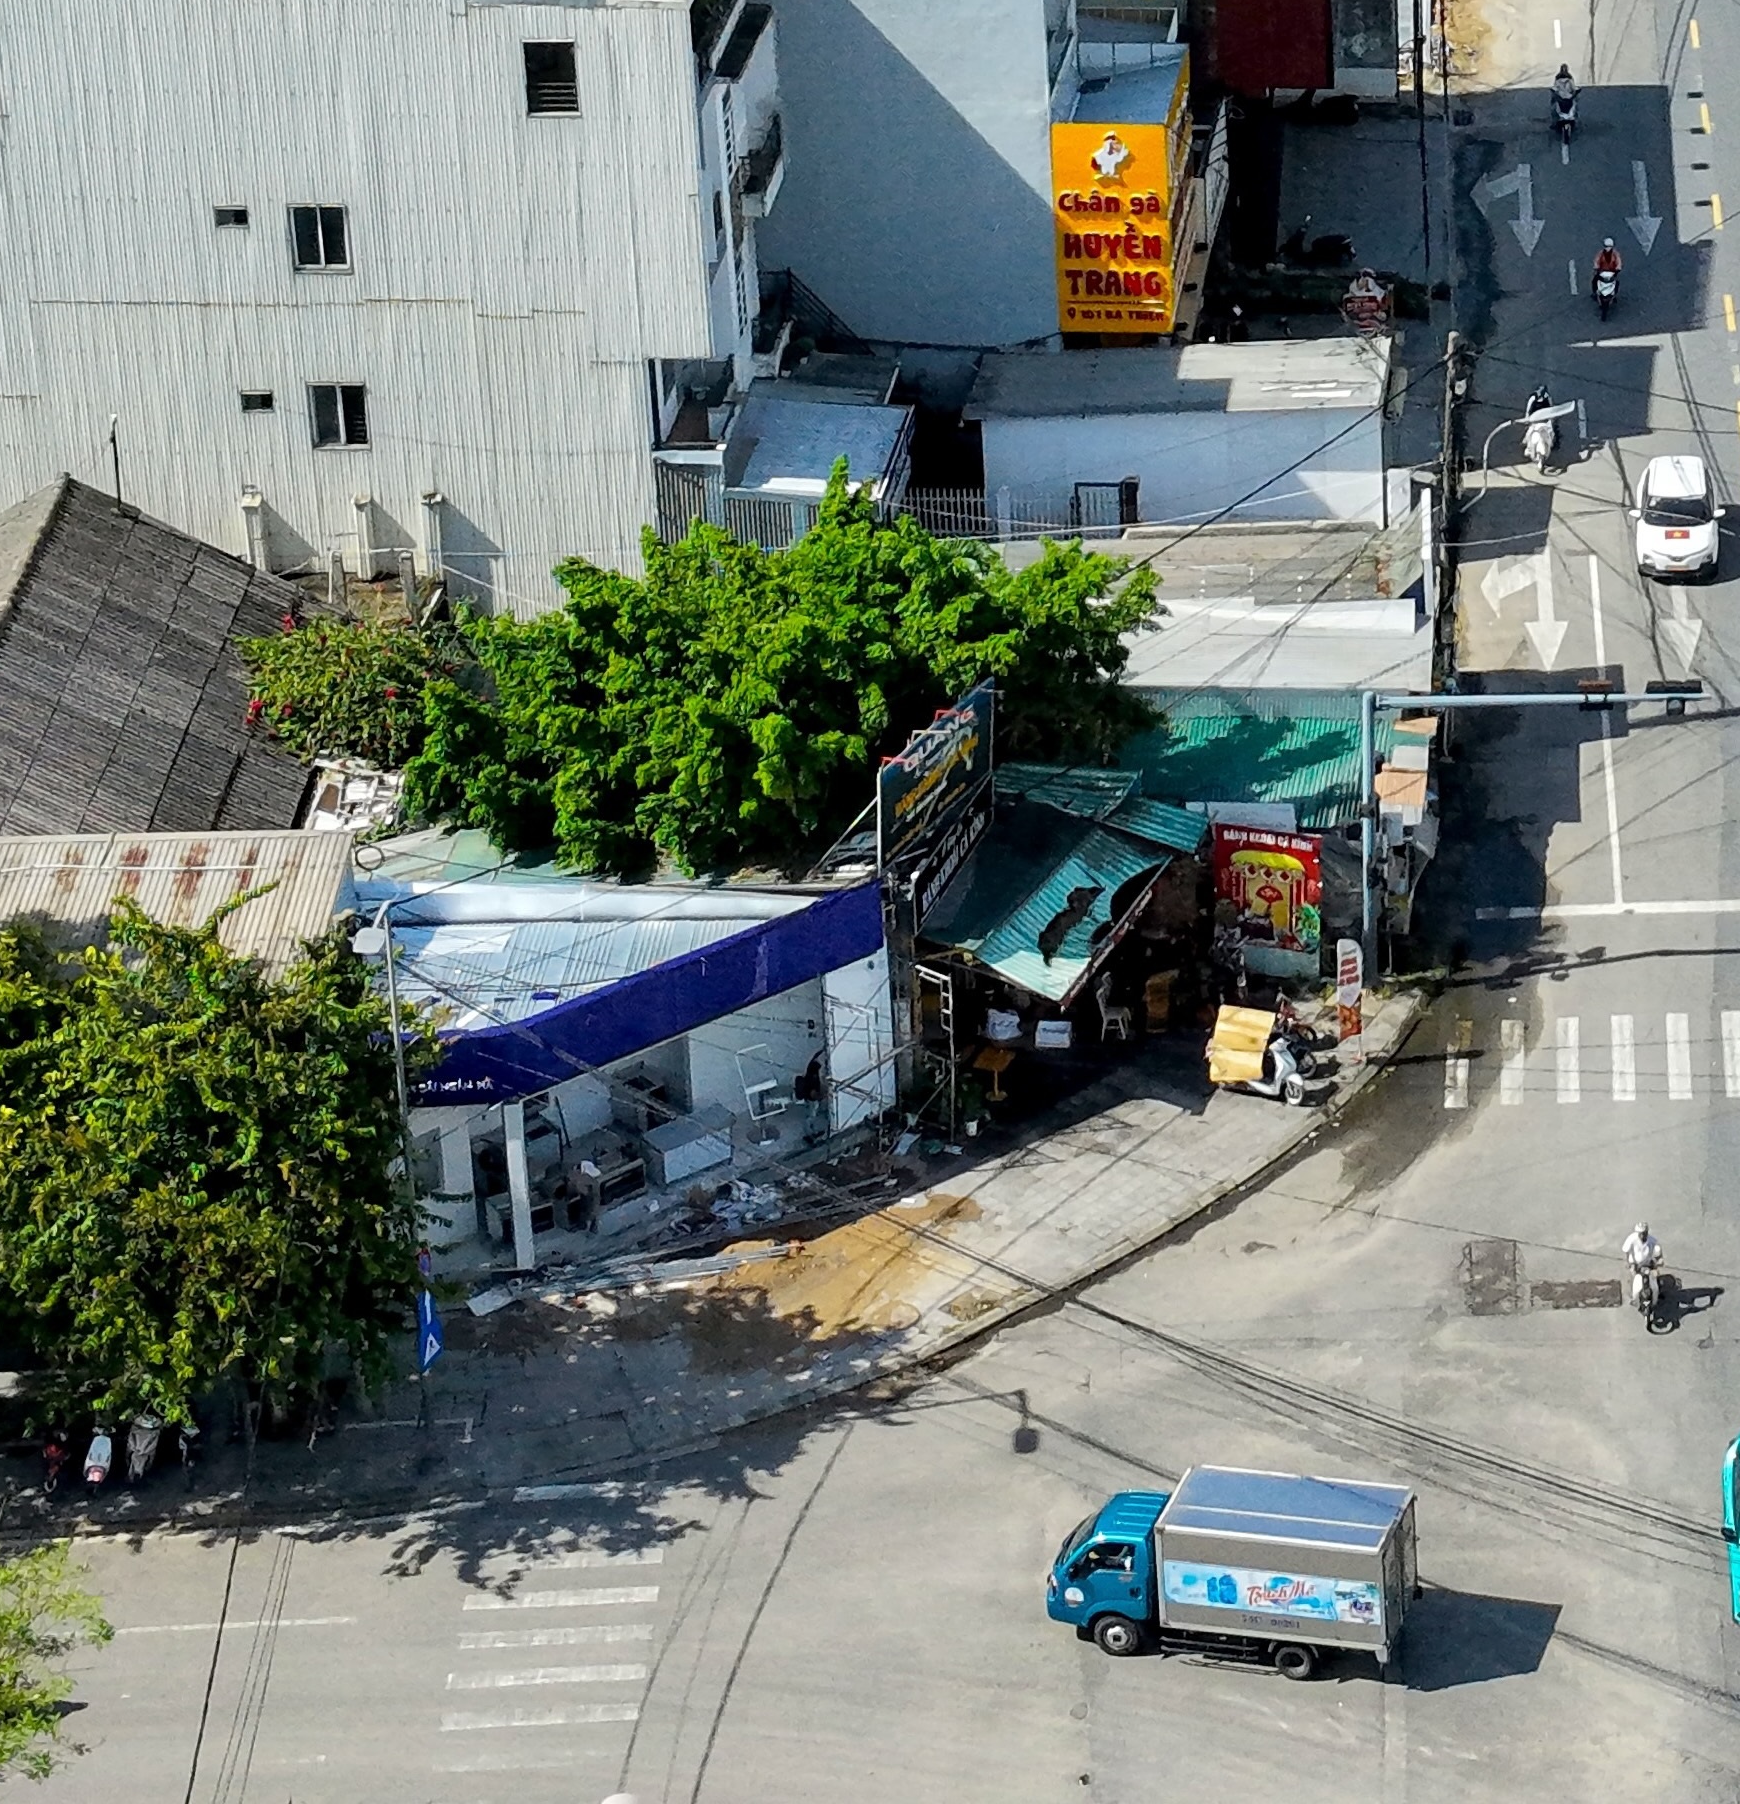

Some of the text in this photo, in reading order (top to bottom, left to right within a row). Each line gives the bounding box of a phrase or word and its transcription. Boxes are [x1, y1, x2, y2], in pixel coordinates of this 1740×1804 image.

[1058, 190, 1161, 216] Chân gà
[1065, 269, 1162, 298] TRANG
